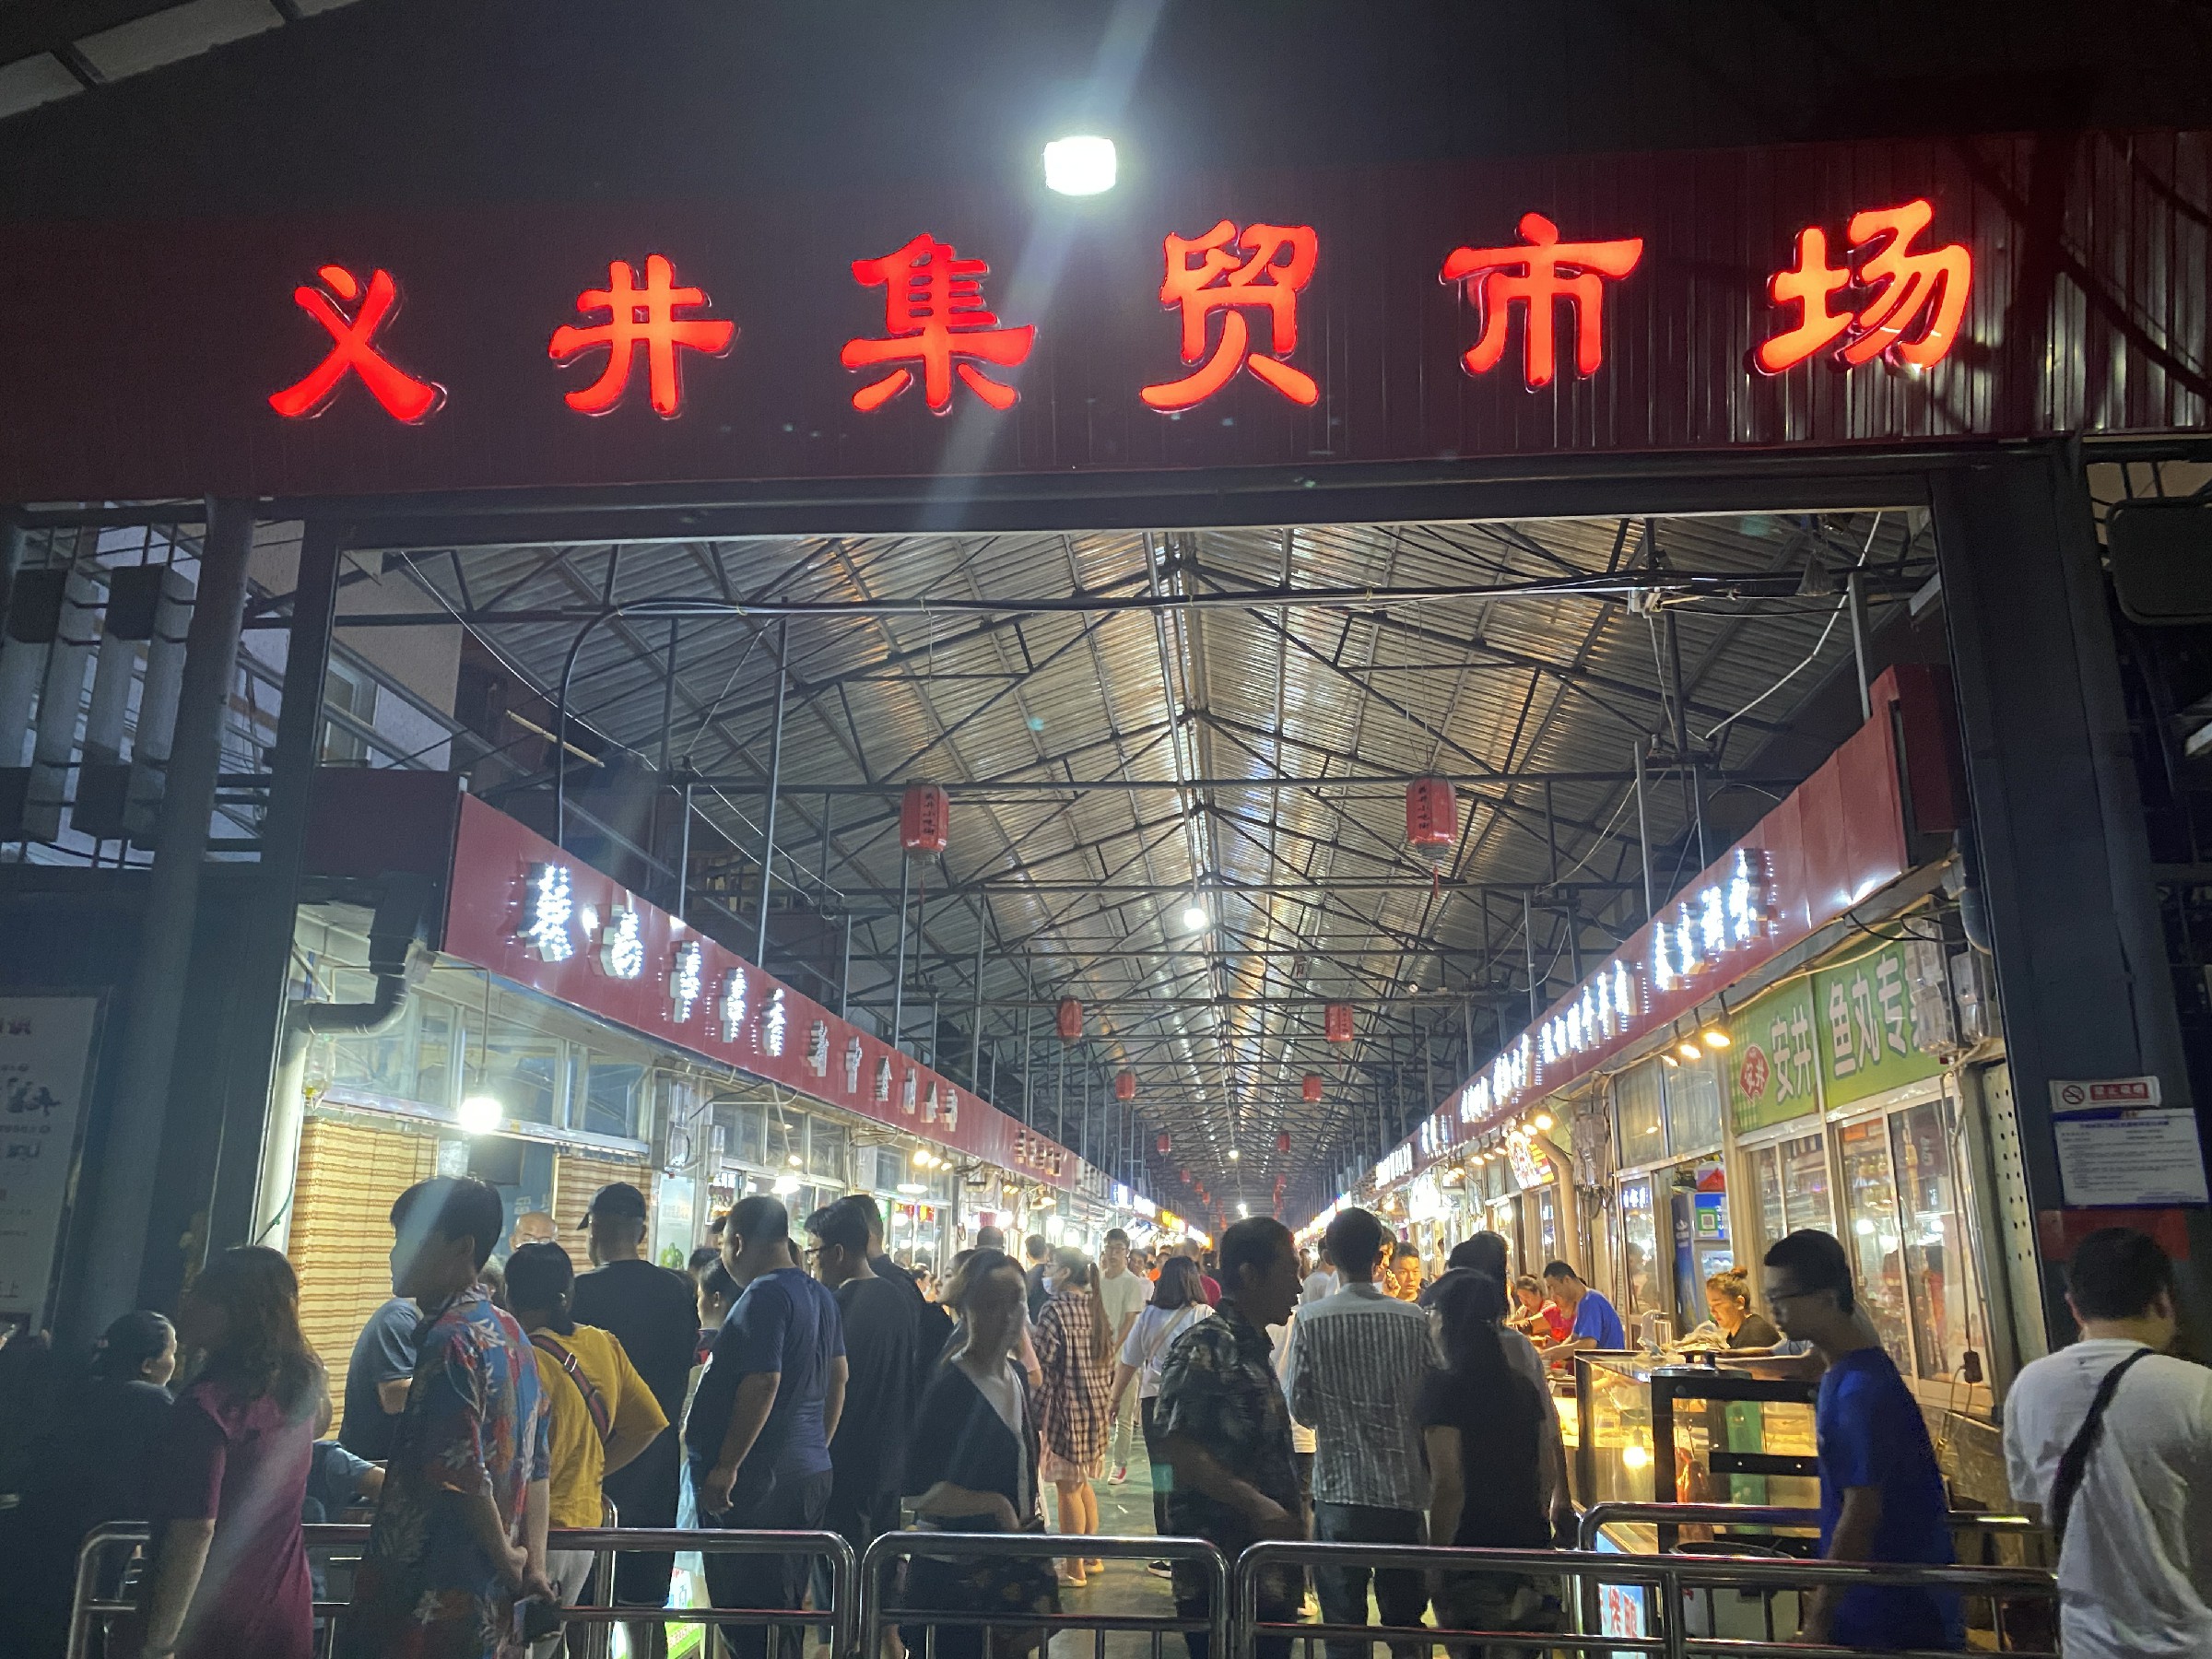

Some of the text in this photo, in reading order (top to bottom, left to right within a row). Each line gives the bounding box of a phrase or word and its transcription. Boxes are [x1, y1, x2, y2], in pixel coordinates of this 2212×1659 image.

[268, 198, 1971, 422] 义井集贸市场
[1771, 1005, 1812, 1102] 安井
